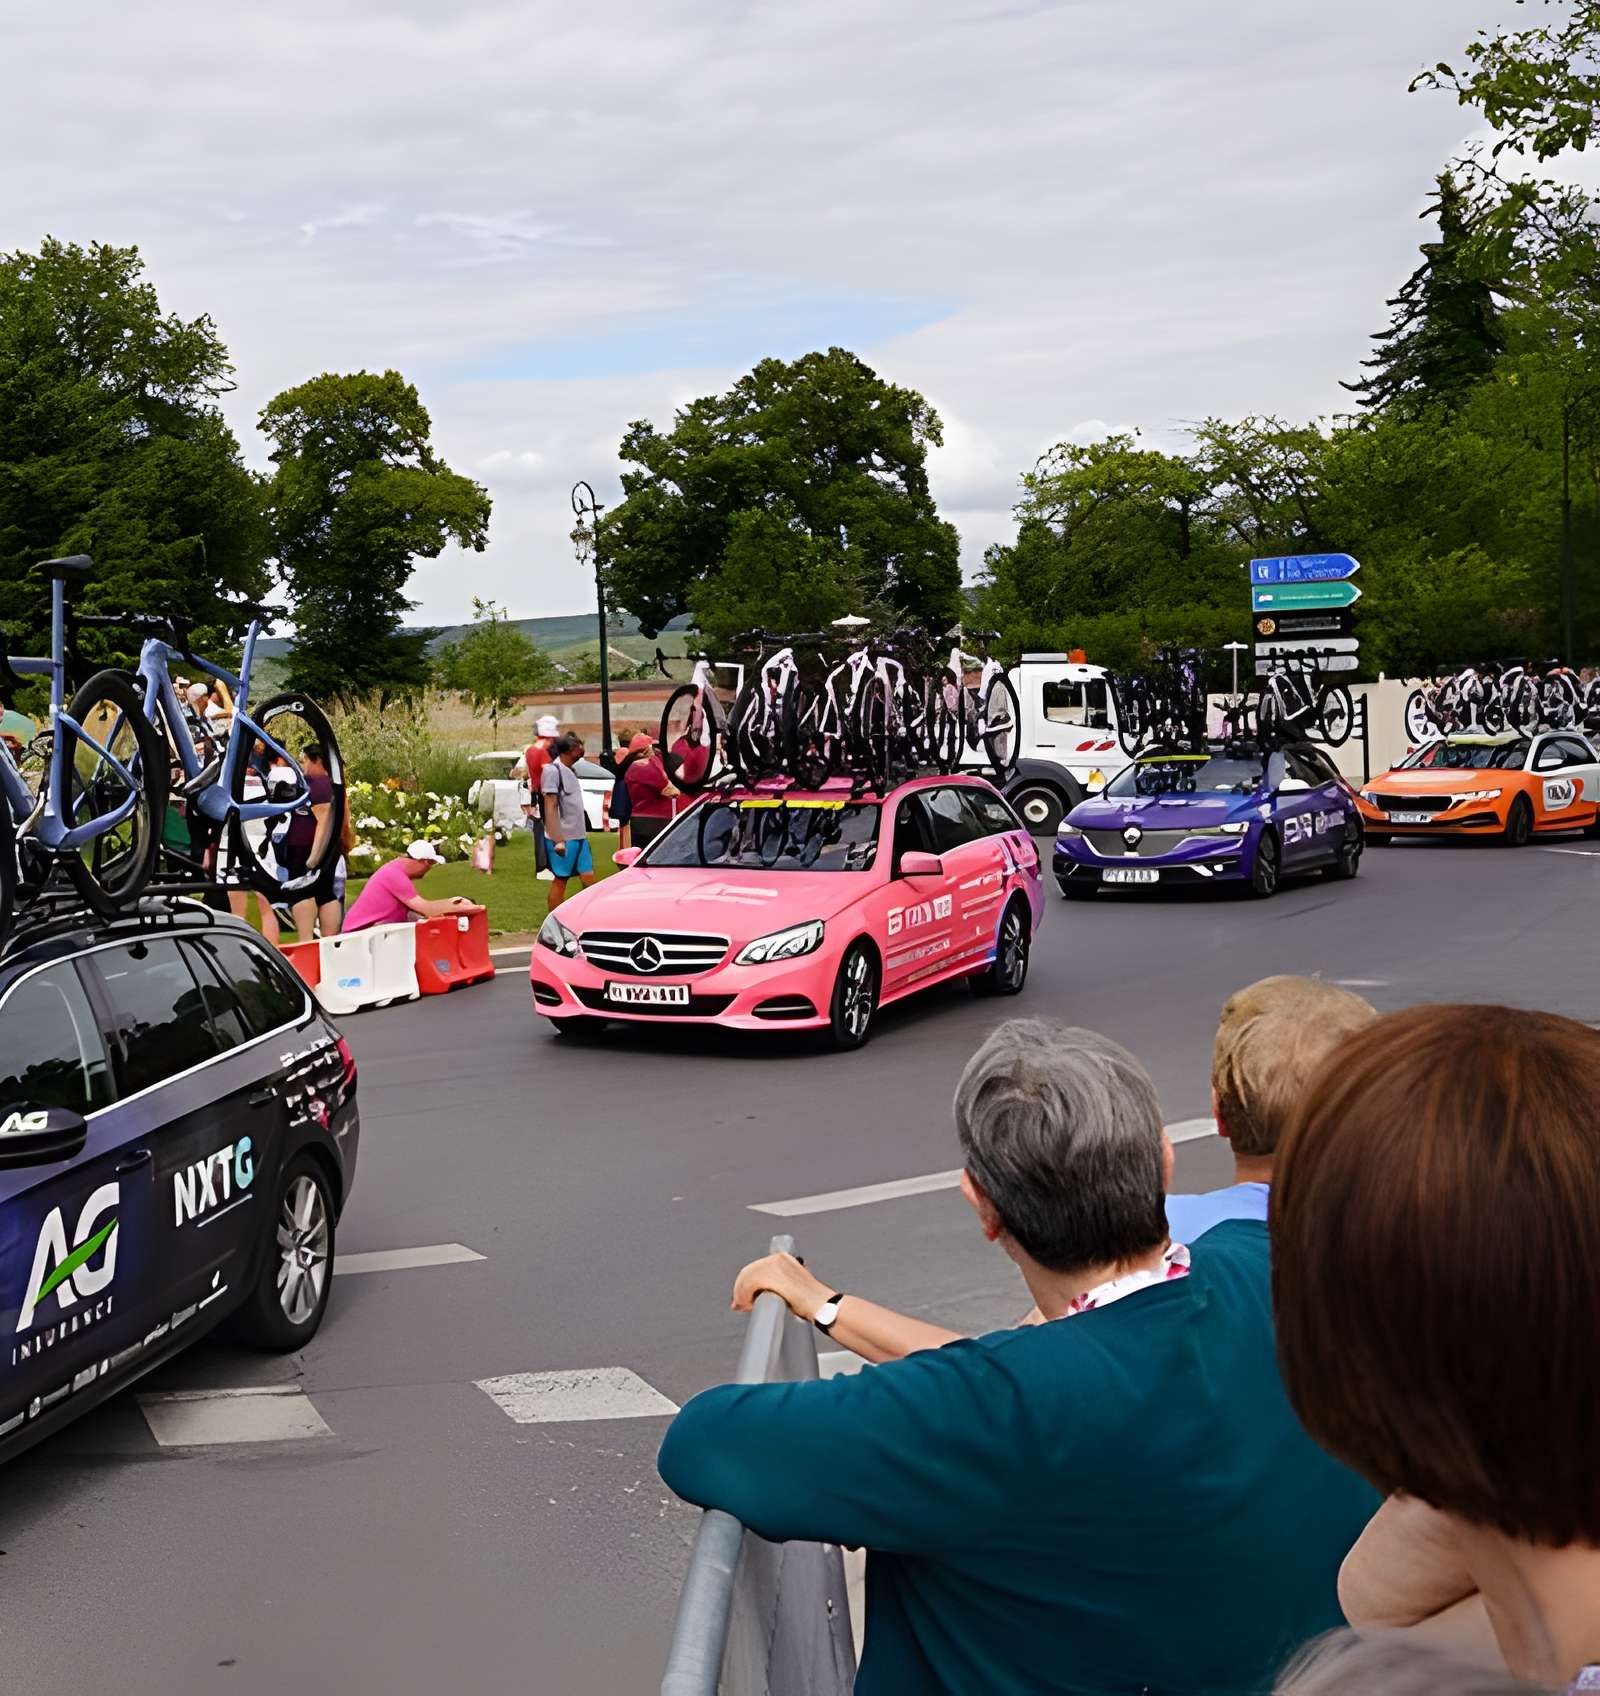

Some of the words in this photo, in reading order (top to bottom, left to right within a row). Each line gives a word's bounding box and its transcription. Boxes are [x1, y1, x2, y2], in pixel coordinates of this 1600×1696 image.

[0, 1111, 48, 1131] AG
[174, 1135, 254, 1227] NXTG
[16, 1182, 119, 1333] AG
